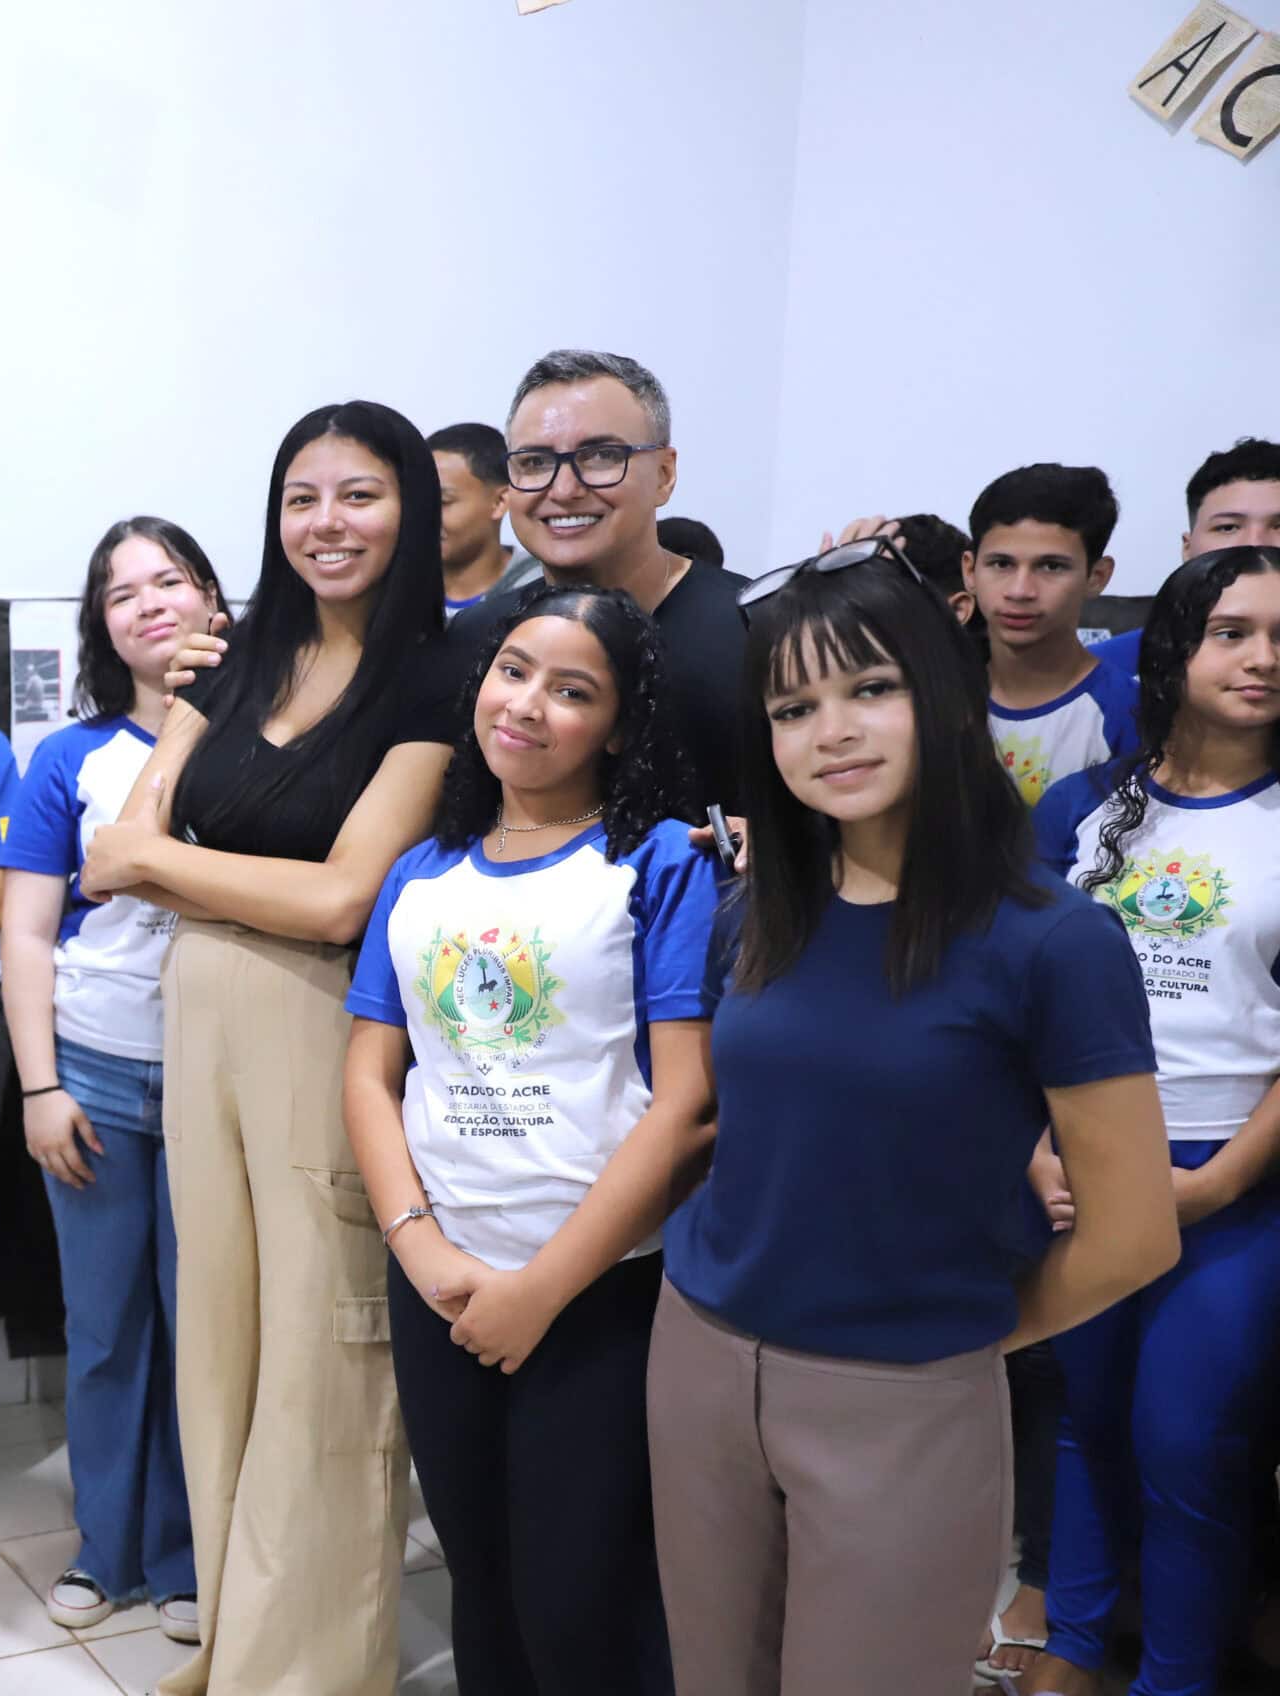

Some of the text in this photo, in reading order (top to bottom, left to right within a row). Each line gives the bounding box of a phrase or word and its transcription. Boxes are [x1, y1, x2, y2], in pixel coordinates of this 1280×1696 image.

[1152, 953, 1173, 965] DO
[1176, 956, 1212, 970] ACRE
[1159, 979, 1210, 993] CULTURA
[1147, 988, 1183, 1000] ORTES
[511, 1084, 552, 1099] ACRE
[459, 1126, 528, 1138] E ESPORTES
